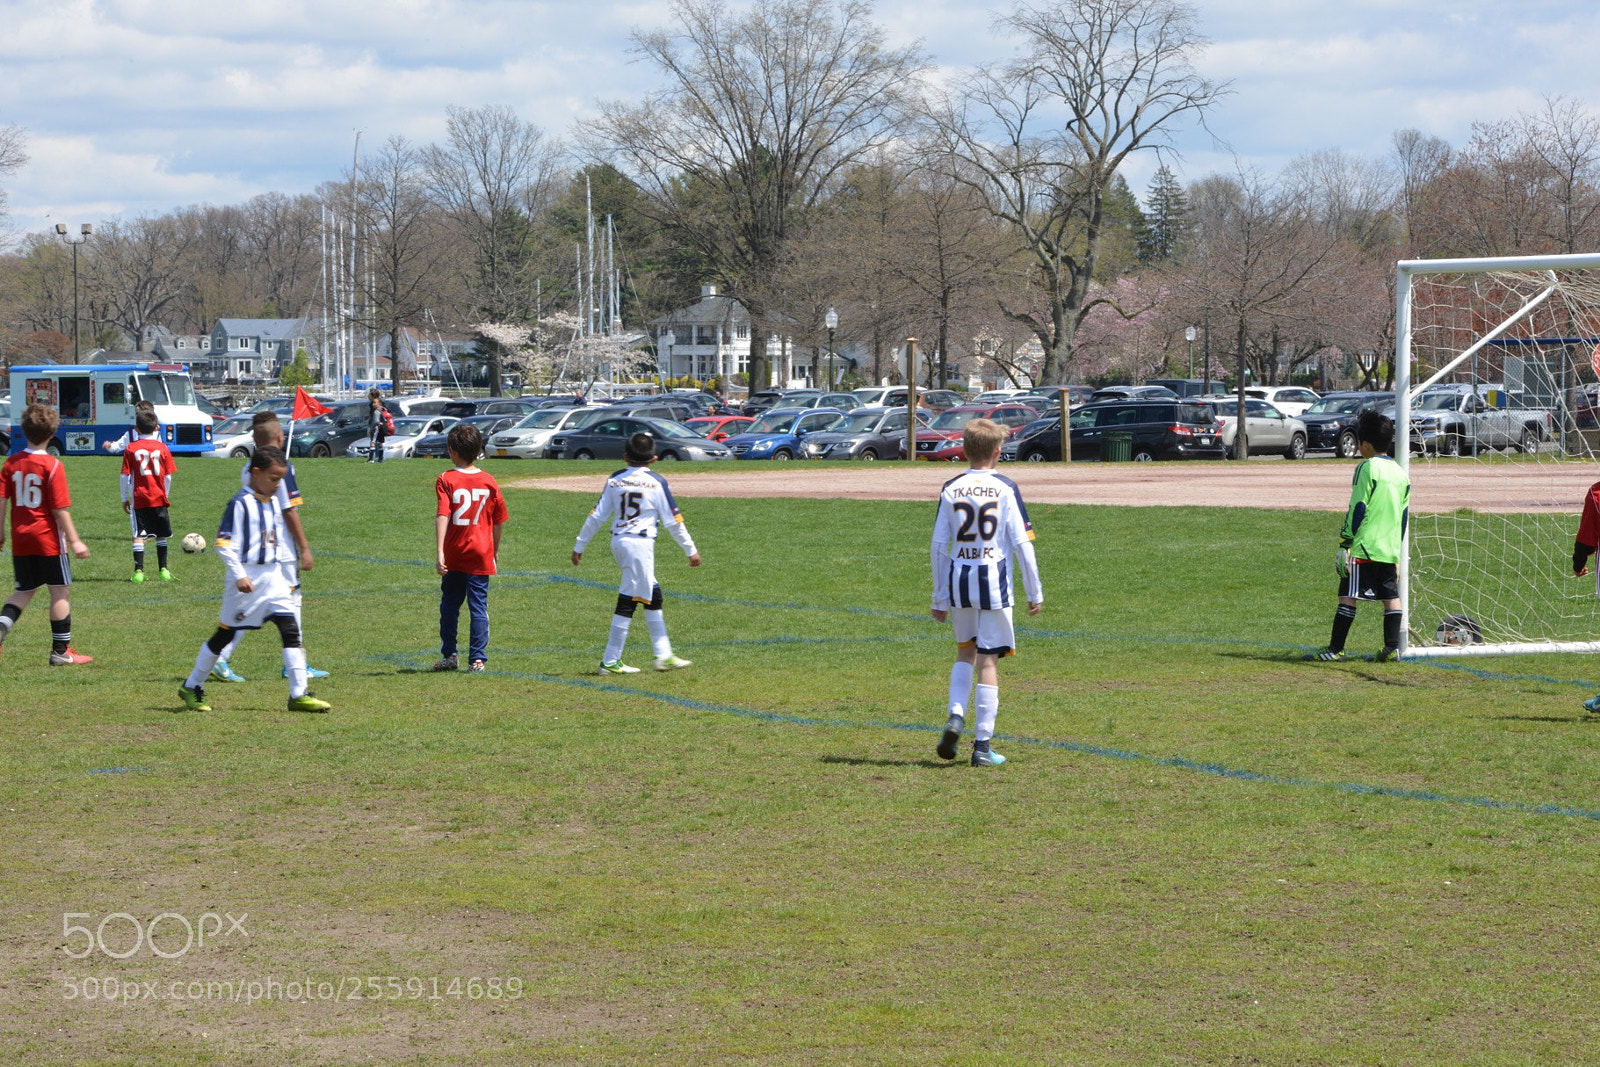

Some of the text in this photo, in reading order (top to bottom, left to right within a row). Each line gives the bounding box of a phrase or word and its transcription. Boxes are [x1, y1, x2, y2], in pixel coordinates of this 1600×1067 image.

[134, 449, 161, 476] 21
[12, 470, 42, 509] 16
[953, 486, 1001, 498] TKACHEV
[453, 488, 490, 526] 27
[619, 491, 643, 520] 15
[953, 501, 998, 542] 26
[982, 547, 994, 559] FC
